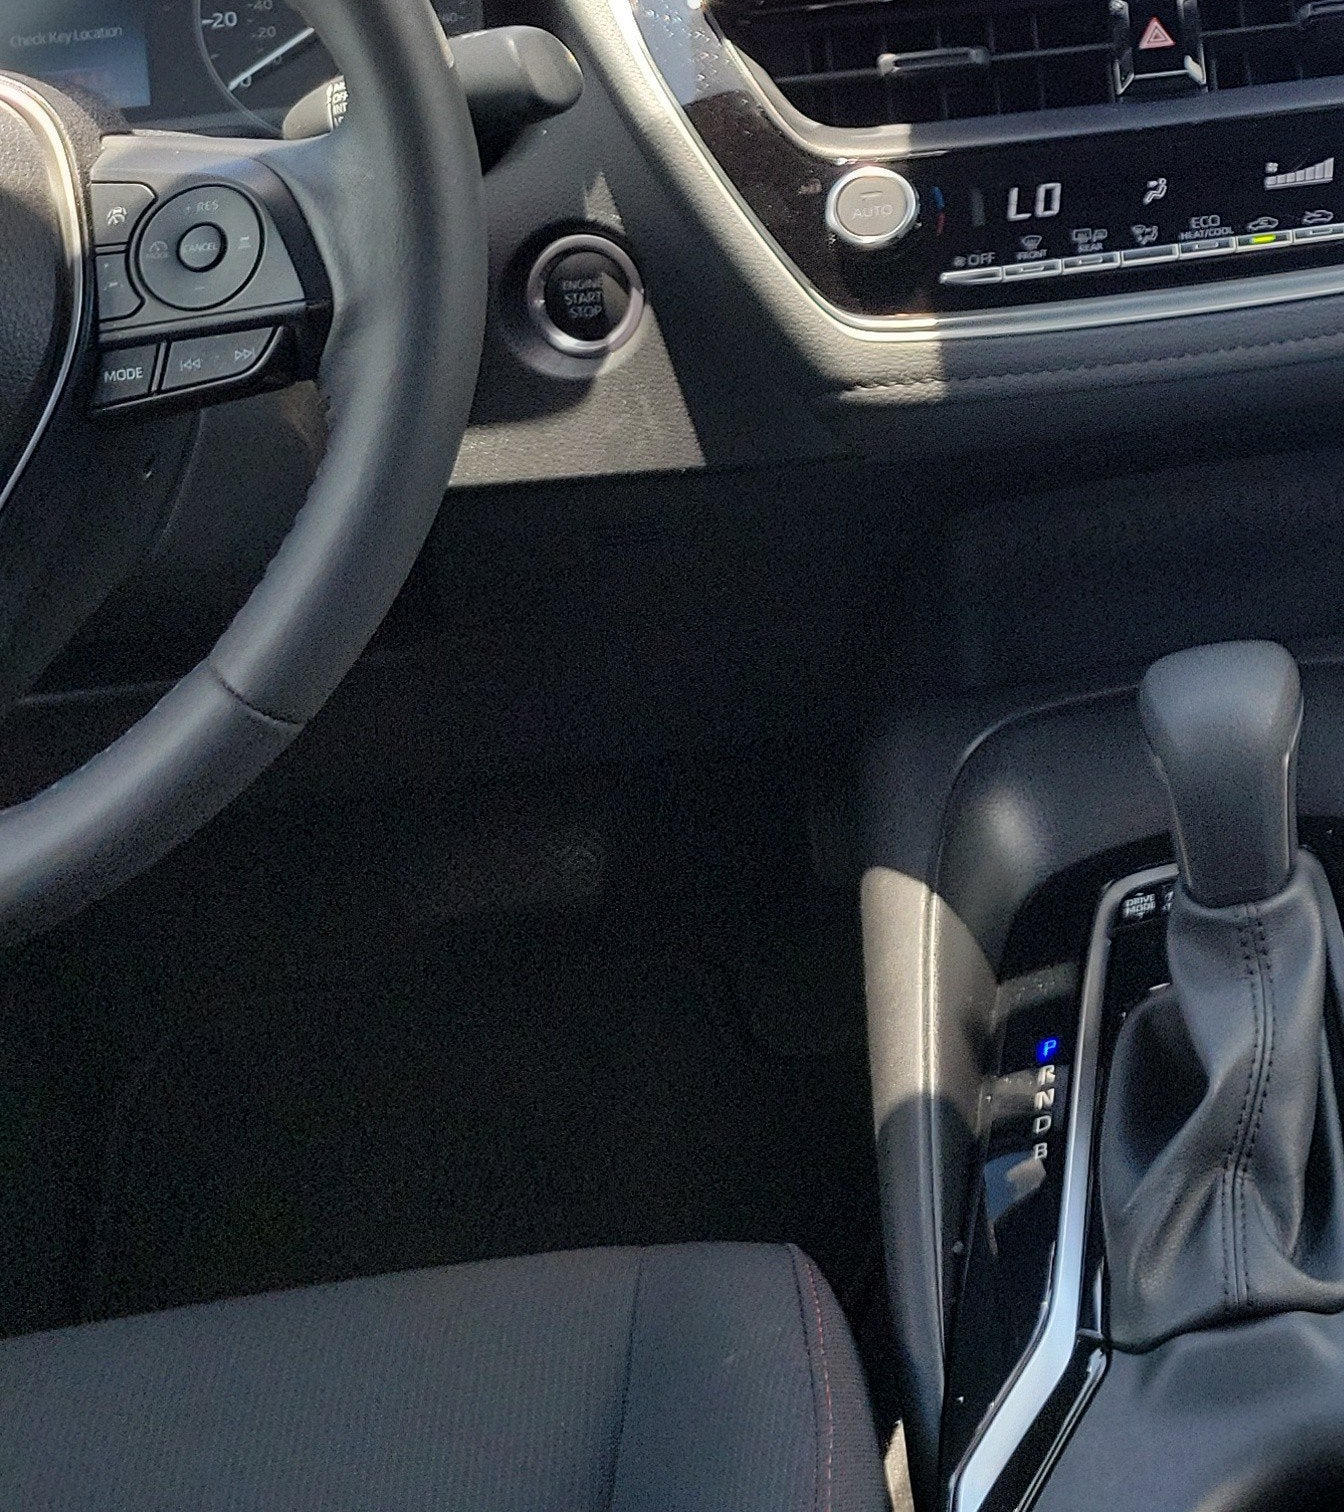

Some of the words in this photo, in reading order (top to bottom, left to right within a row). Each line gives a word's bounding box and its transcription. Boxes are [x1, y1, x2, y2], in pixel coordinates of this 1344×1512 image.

[211, 11, 238, 29] 20
[74, 26, 123, 41] Location
[258, 25, 277, 38] 20
[1006, 182, 1062, 222] LO
[852, 204, 893, 220] AUTO
[1191, 215, 1221, 229] ECO
[1180, 226, 1234, 240] HEAT/COOL
[185, 241, 218, 252] CANCEL
[1078, 242, 1104, 253] REAR
[967, 252, 996, 266] OFF
[1016, 248, 1048, 261] FRONT
[563, 291, 603, 306] START
[569, 305, 602, 319] STOP
[103, 366, 144, 383] MODE
[1125, 893, 1156, 907] DRIVE
[1125, 901, 1156, 916] MODE
[1043, 1039, 1057, 1057] P
[1038, 1064, 1056, 1085] R
[1034, 1088, 1055, 1109] N
[1034, 1115, 1052, 1133] D
[1034, 1142, 1048, 1159] B
